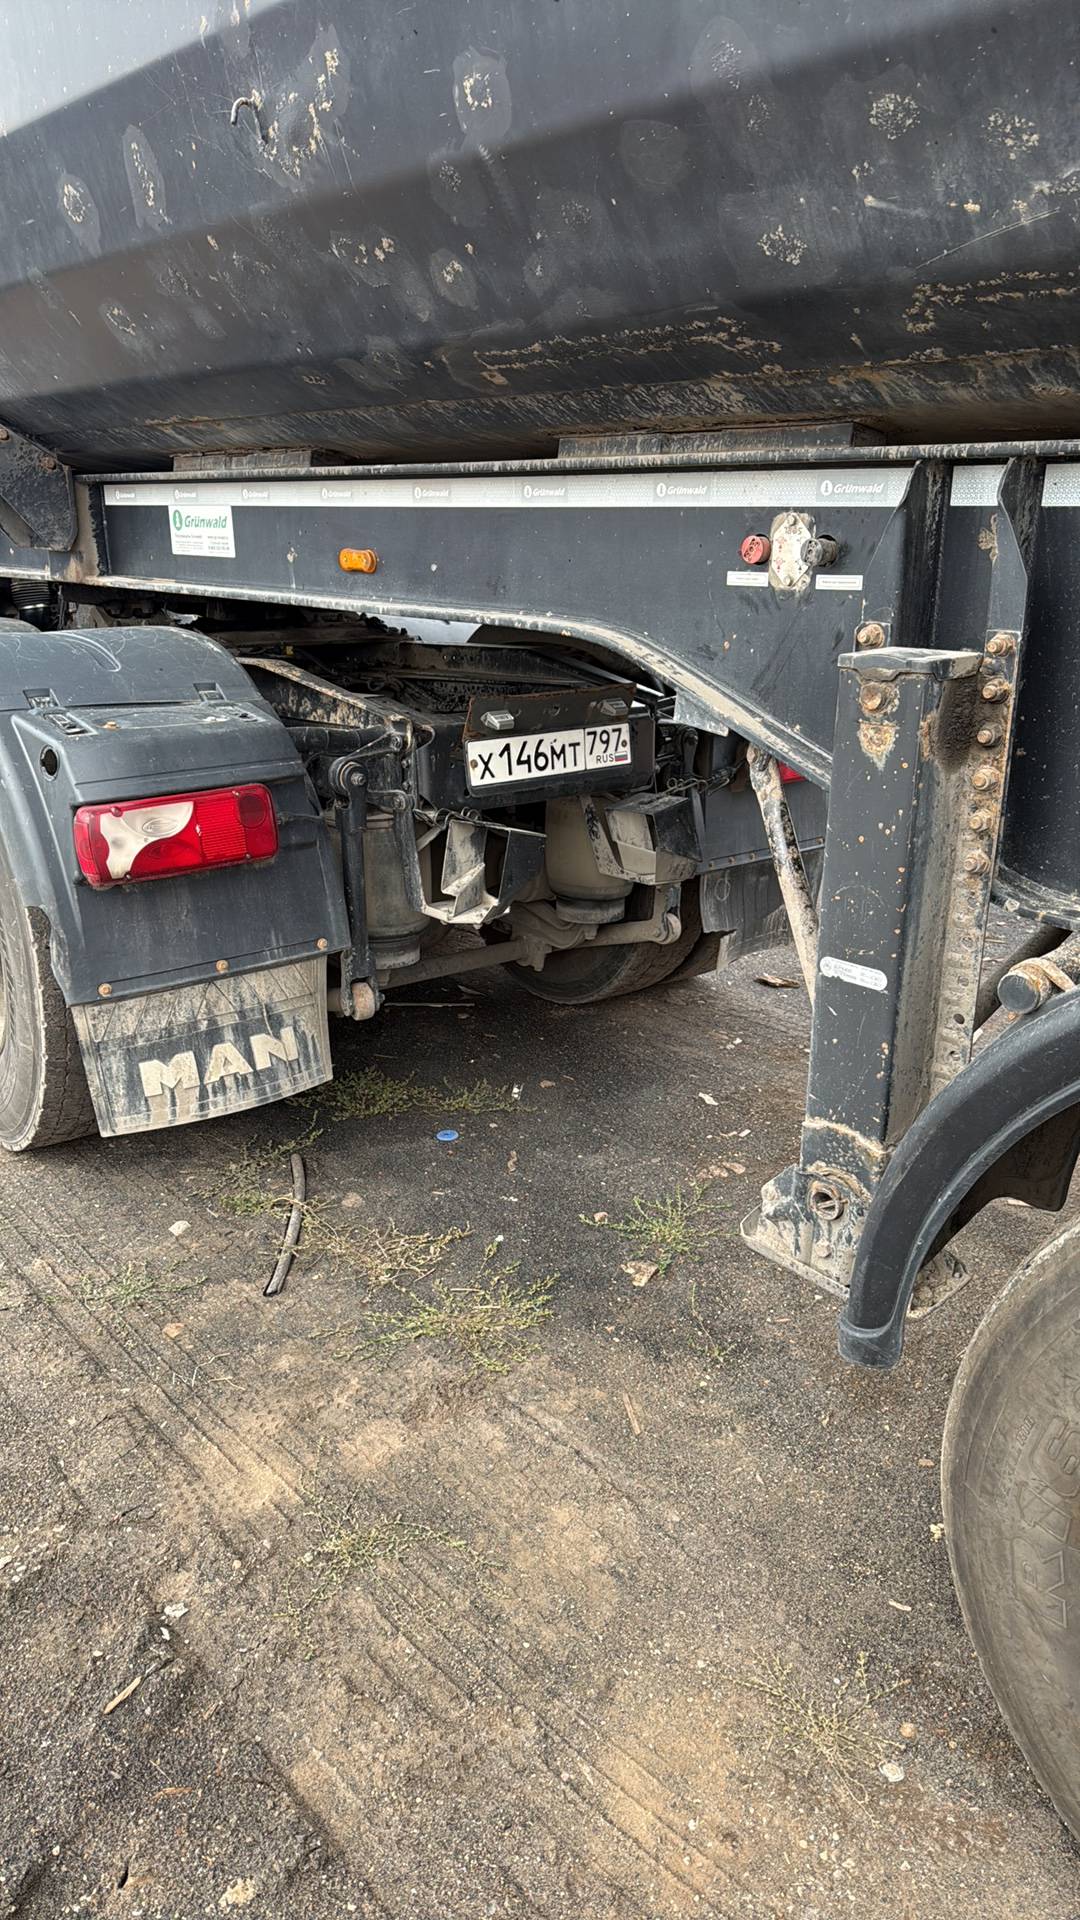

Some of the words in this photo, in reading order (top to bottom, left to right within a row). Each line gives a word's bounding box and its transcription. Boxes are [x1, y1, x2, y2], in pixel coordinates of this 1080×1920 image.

[667, 485, 708, 496] Grünwald
[833, 482, 885, 494] Grünwald
[184, 515, 228, 529] Grünwald
[586, 728, 622, 756] 797
[596, 753, 615, 764] RUS
[138, 1026, 299, 1097] MAN
